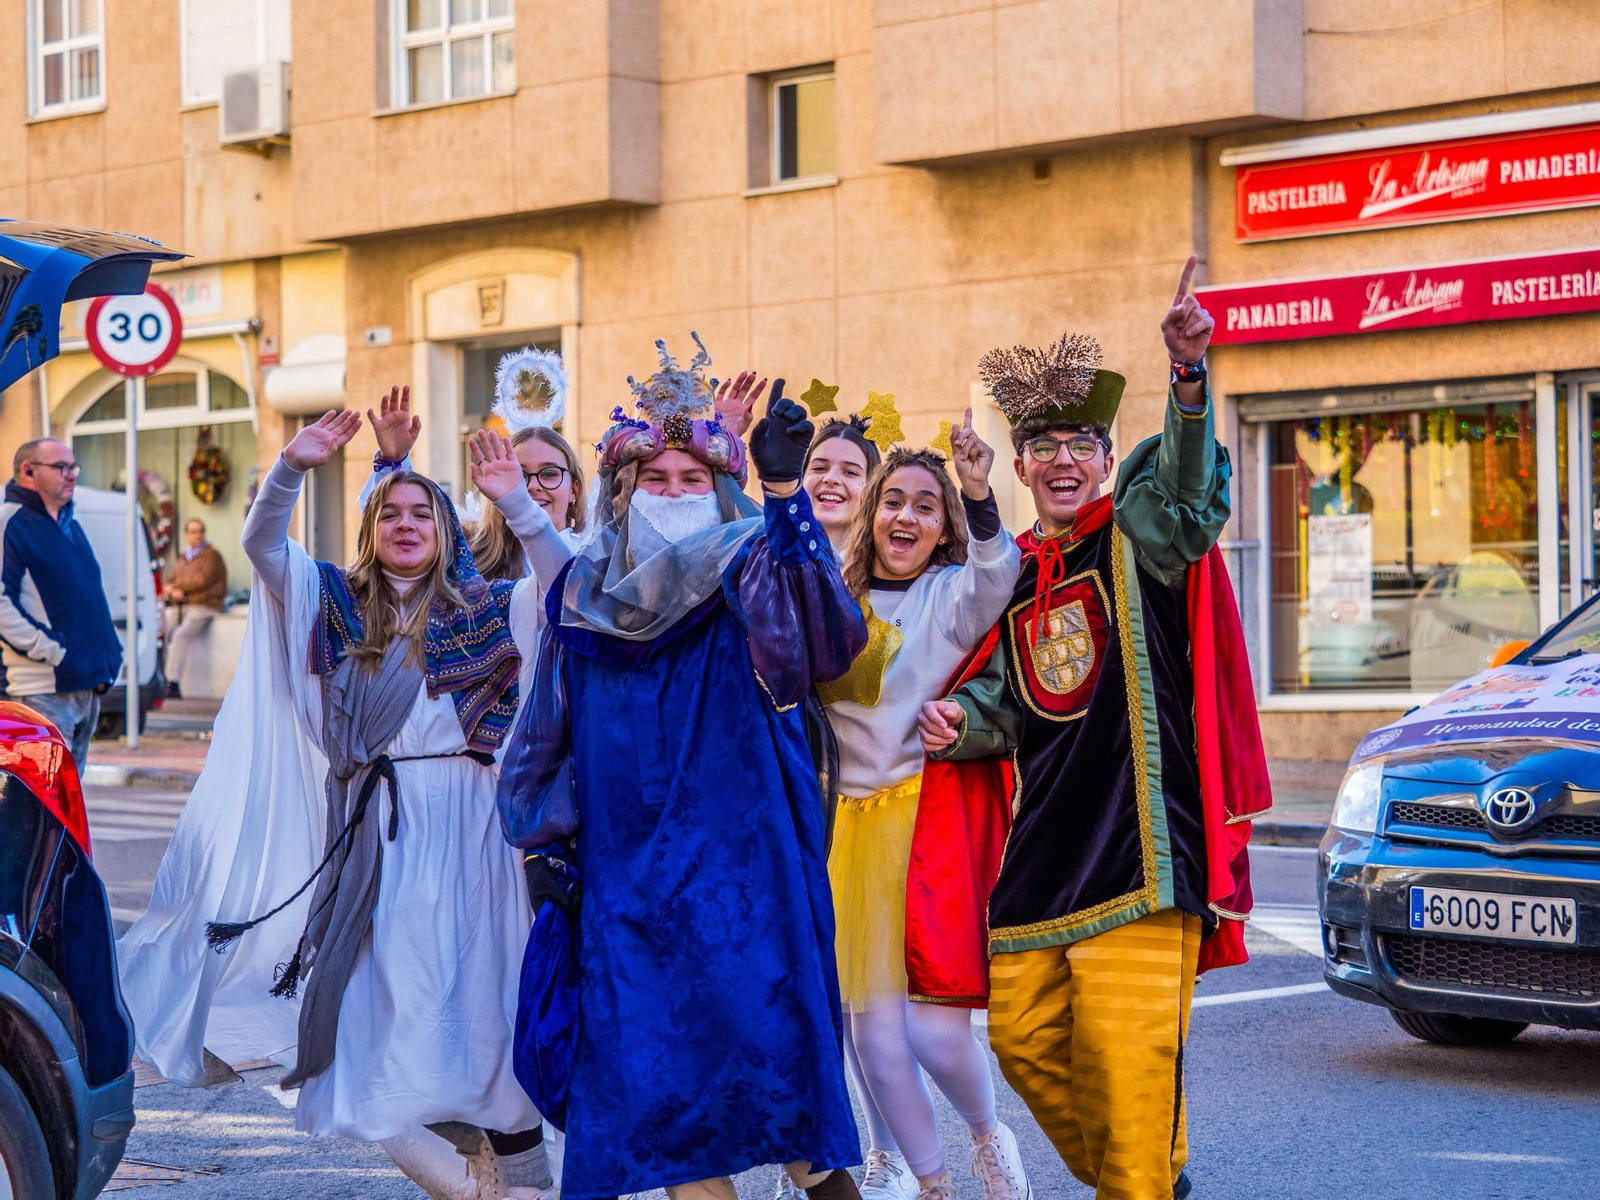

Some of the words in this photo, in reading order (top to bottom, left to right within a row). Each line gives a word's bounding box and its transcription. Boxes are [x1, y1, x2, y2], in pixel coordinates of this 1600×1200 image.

[1362, 158, 1398, 206] La
[1500, 147, 1600, 184] PANADERÍ
[1248, 179, 1347, 215] PASTELERÍA
[1227, 295, 1333, 331] PANADERÍA
[1361, 278, 1390, 317] La
[109, 312, 162, 342] 30
[1424, 717, 1567, 736] Hermandad
[1567, 718, 1600, 732] de
[1414, 912, 1421, 922] E
[1429, 894, 1500, 931] 6009
[1511, 901, 1571, 937] FCN
